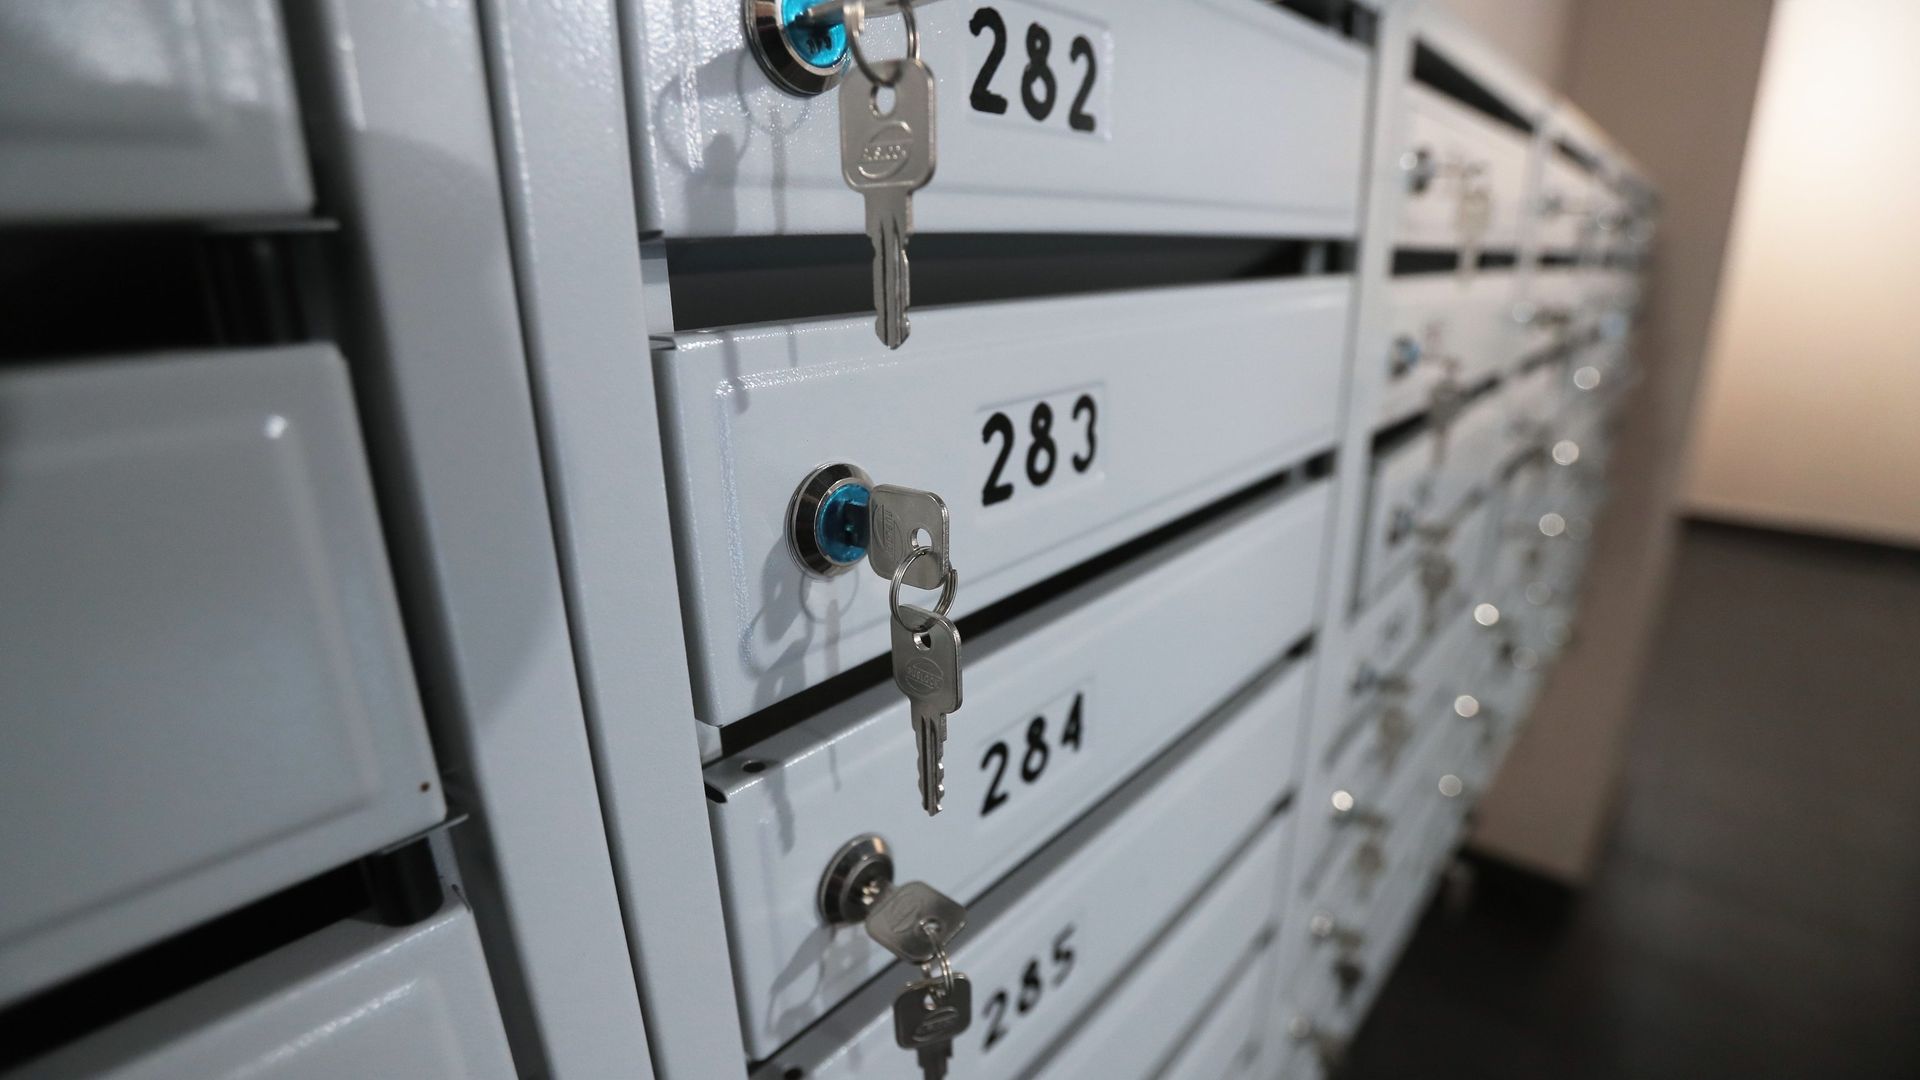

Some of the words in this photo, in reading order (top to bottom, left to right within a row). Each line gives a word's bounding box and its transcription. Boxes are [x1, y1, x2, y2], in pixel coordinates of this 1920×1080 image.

[969, 7, 1097, 132] 282
[982, 394, 1097, 507] 283
[980, 691, 1083, 817] 284
[982, 923, 1076, 1051] 285
